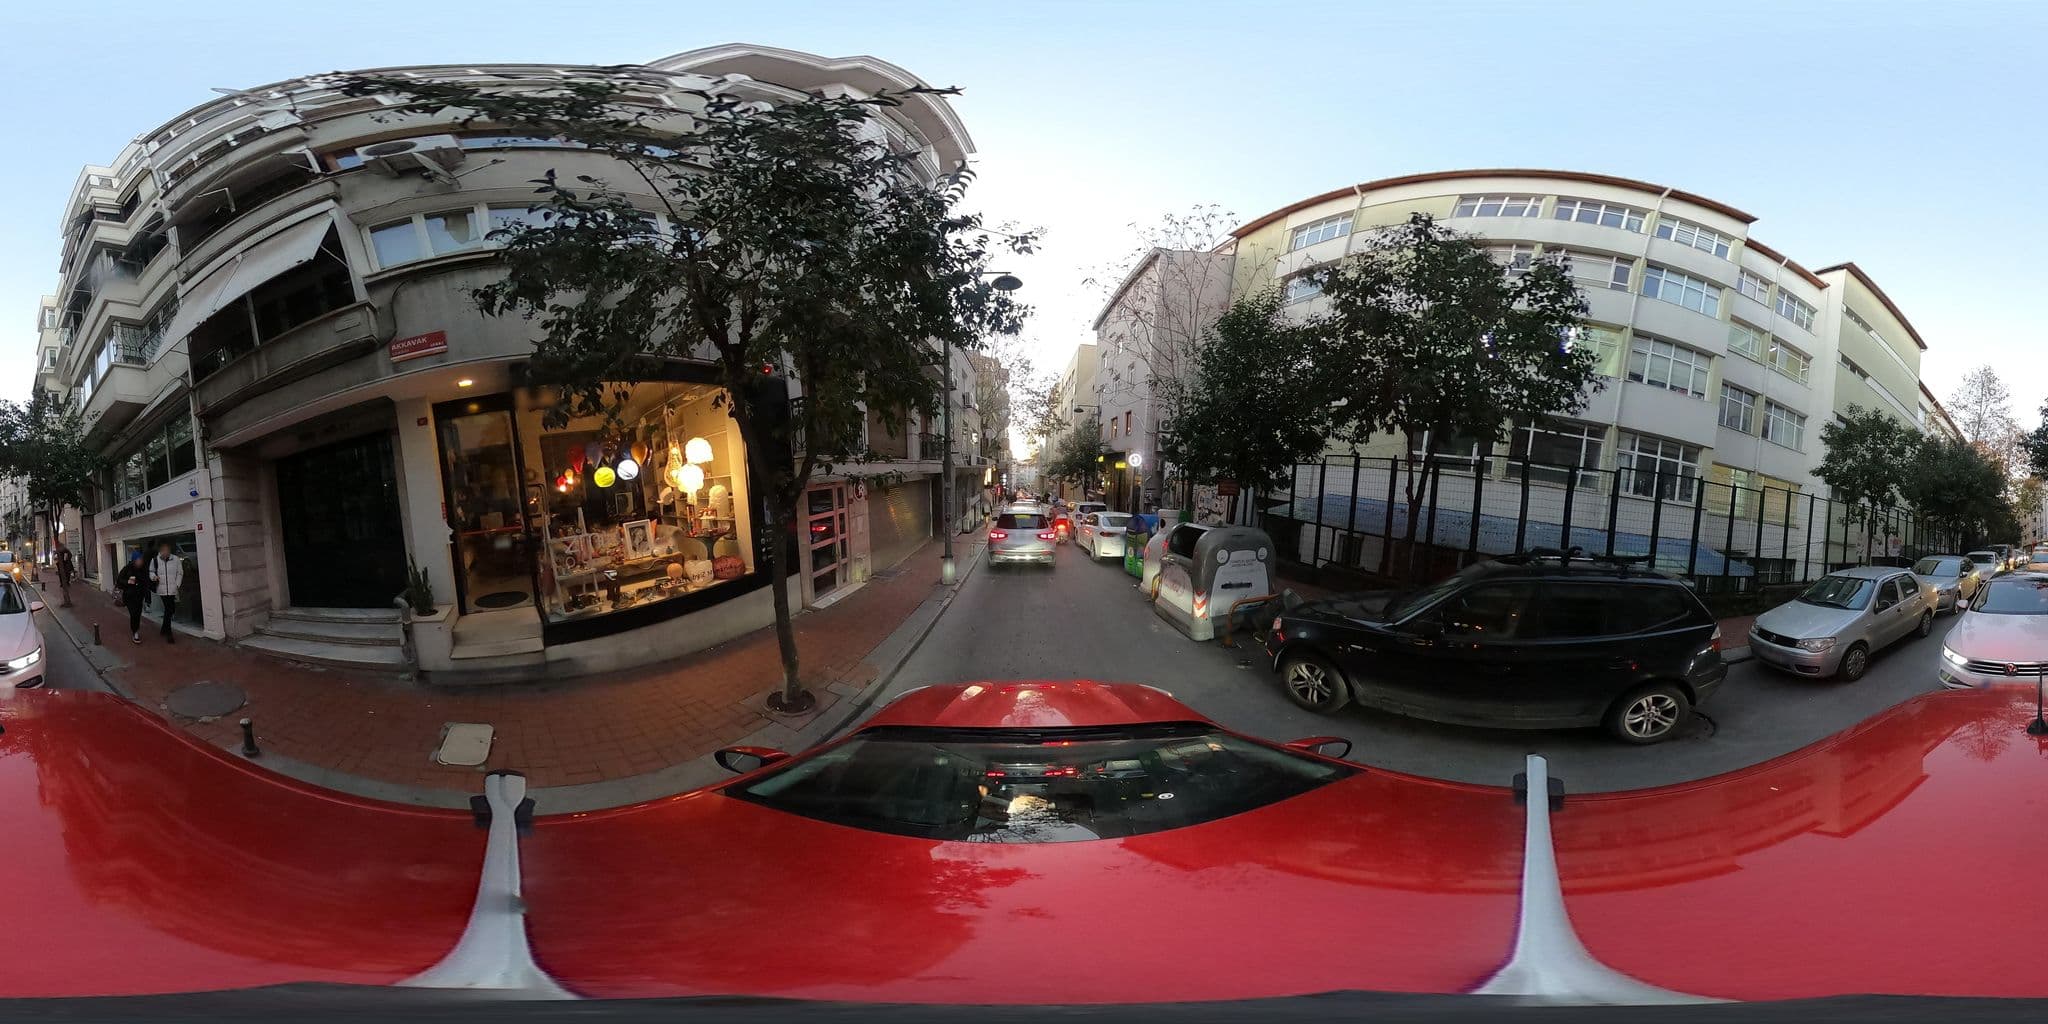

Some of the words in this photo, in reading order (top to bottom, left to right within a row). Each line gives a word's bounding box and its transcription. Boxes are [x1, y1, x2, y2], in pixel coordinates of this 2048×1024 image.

[391, 337, 427, 350] AKKAVAK
[135, 500, 146, 515] No
[146, 495, 152, 510] 8
